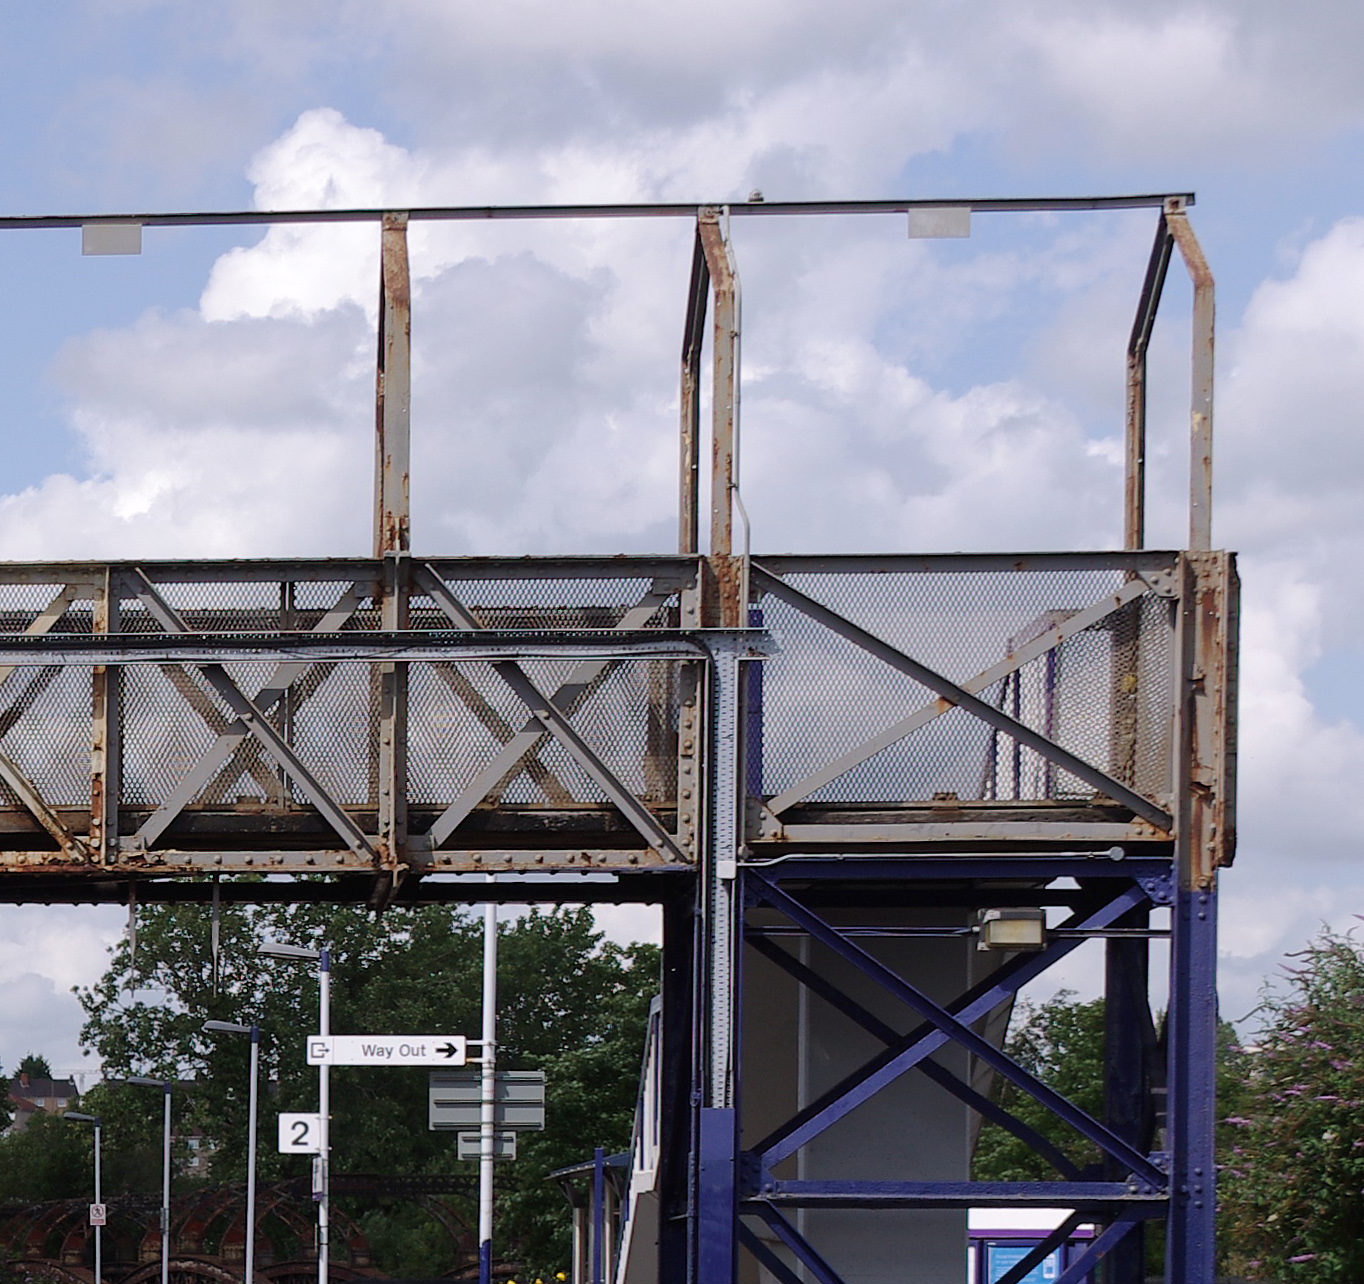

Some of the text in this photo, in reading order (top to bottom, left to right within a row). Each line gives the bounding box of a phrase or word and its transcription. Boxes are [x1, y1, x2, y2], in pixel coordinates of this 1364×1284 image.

[361, 1043, 427, 1060] Way Out
[290, 1120, 310, 1147] 2
